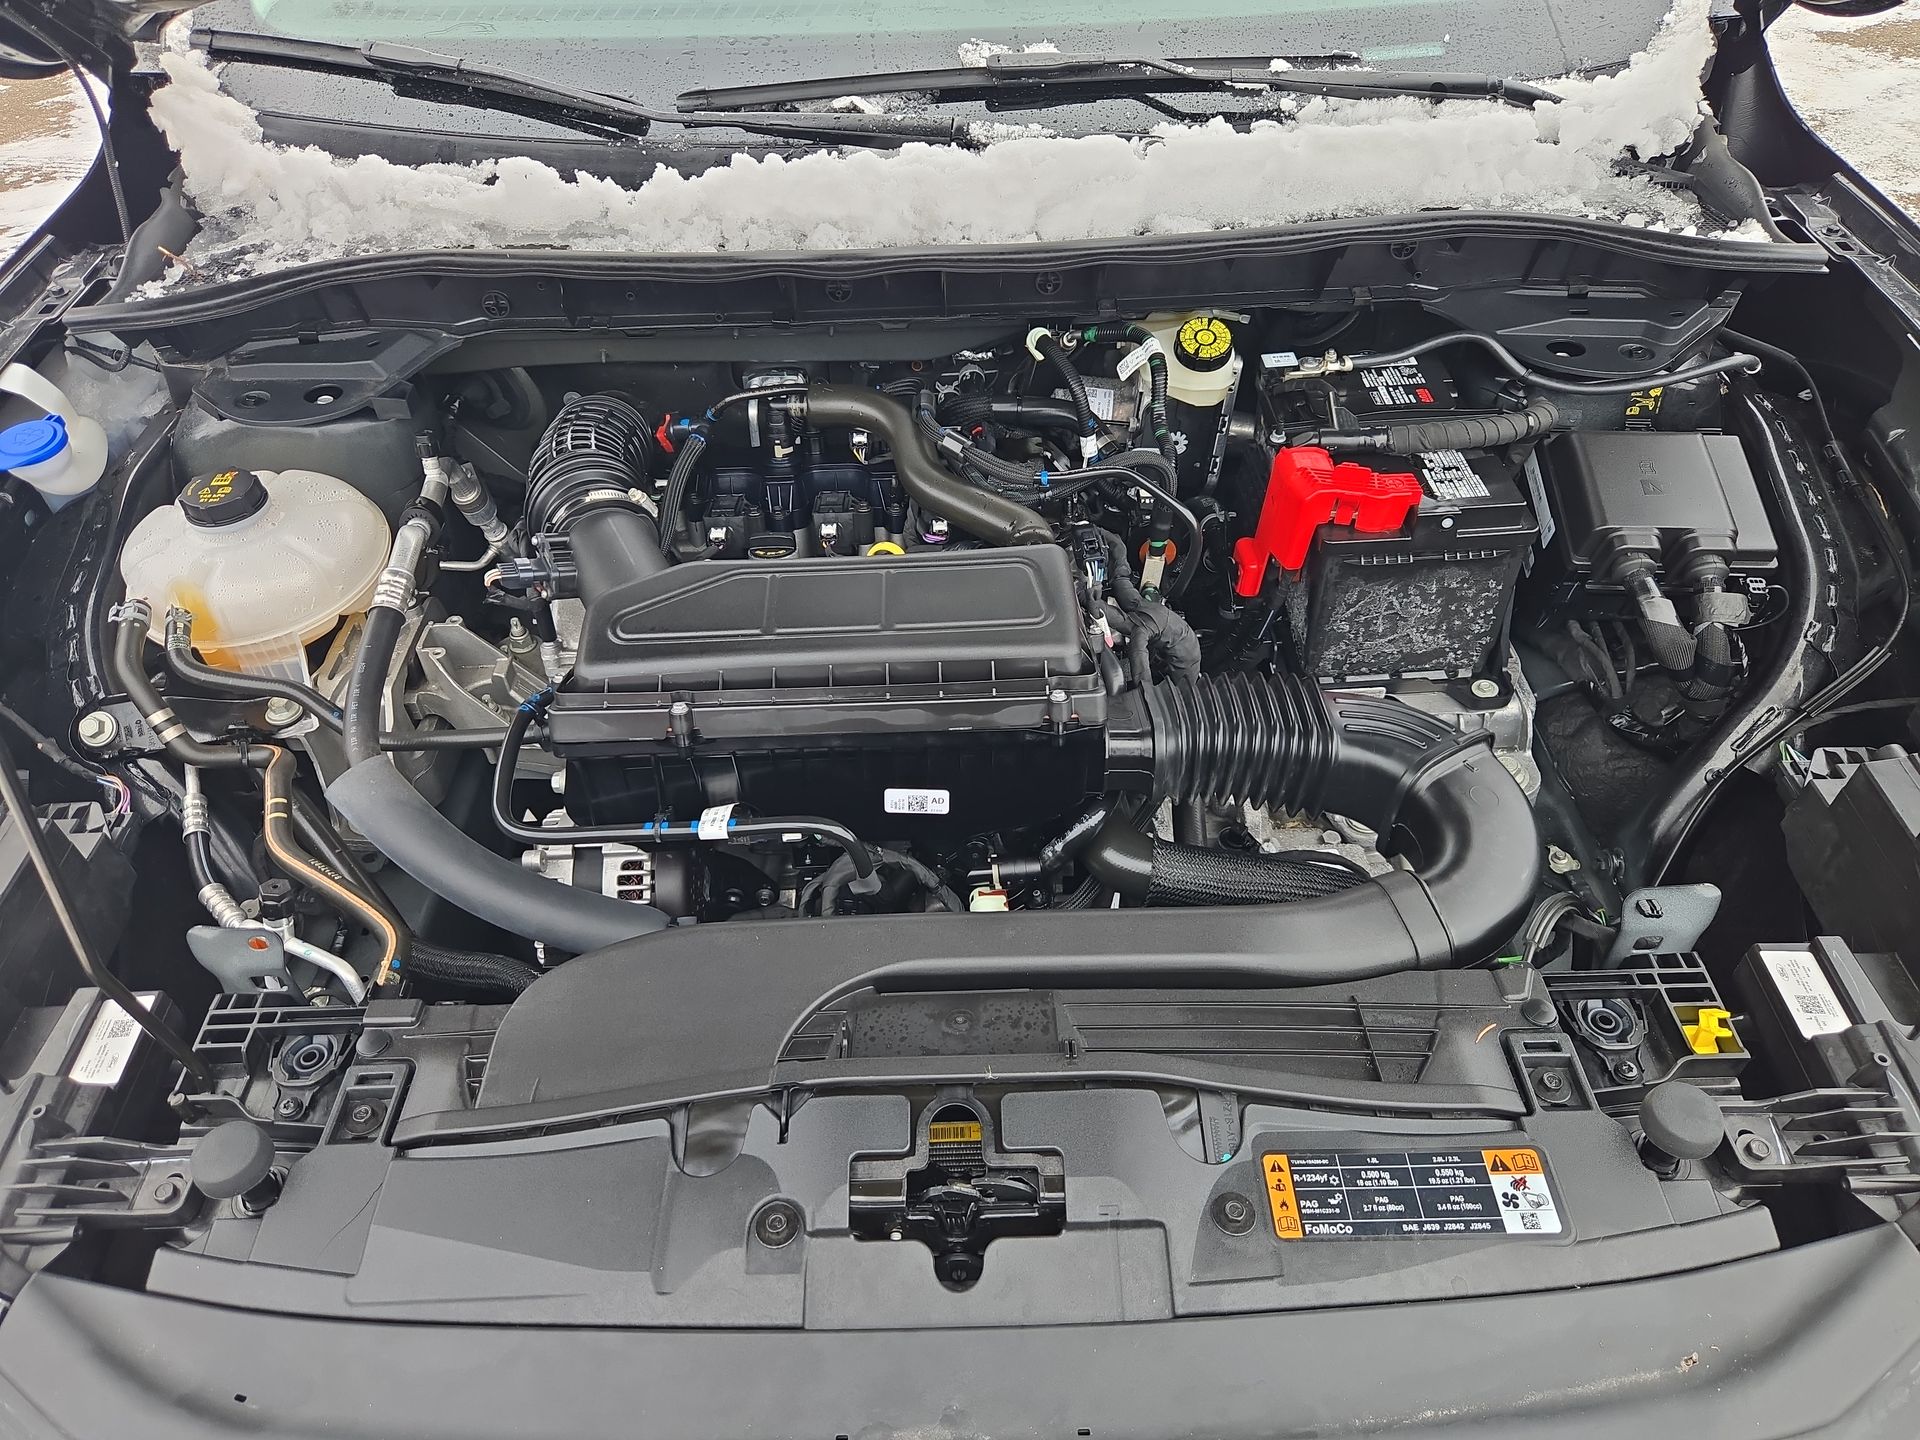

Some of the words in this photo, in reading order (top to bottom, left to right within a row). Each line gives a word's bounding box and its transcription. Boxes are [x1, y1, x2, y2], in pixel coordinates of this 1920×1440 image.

[1361, 1170, 1380, 1179] 0.500
[1380, 1170, 1390, 1180] kg
[1434, 1168, 1454, 1177] 0.550
[1454, 1168, 1465, 1178] kg
[1293, 1173, 1328, 1183] R-1234yf
[1449, 1177, 1464, 1185] (1.21
[1464, 1176, 1476, 1184] lbs)
[1300, 1200, 1319, 1208] PAG
[1374, 1196, 1389, 1204] PAG
[1363, 1204, 1372, 1212] 2.7
[1437, 1203, 1447, 1211] 3.4
[1460, 1202, 1482, 1211] (100cc)
[1304, 1223, 1353, 1235] FoMoCo
[1422, 1223, 1440, 1231] J639
[1443, 1222, 1466, 1231] J2842
[1469, 1222, 1491, 1231] J2845
